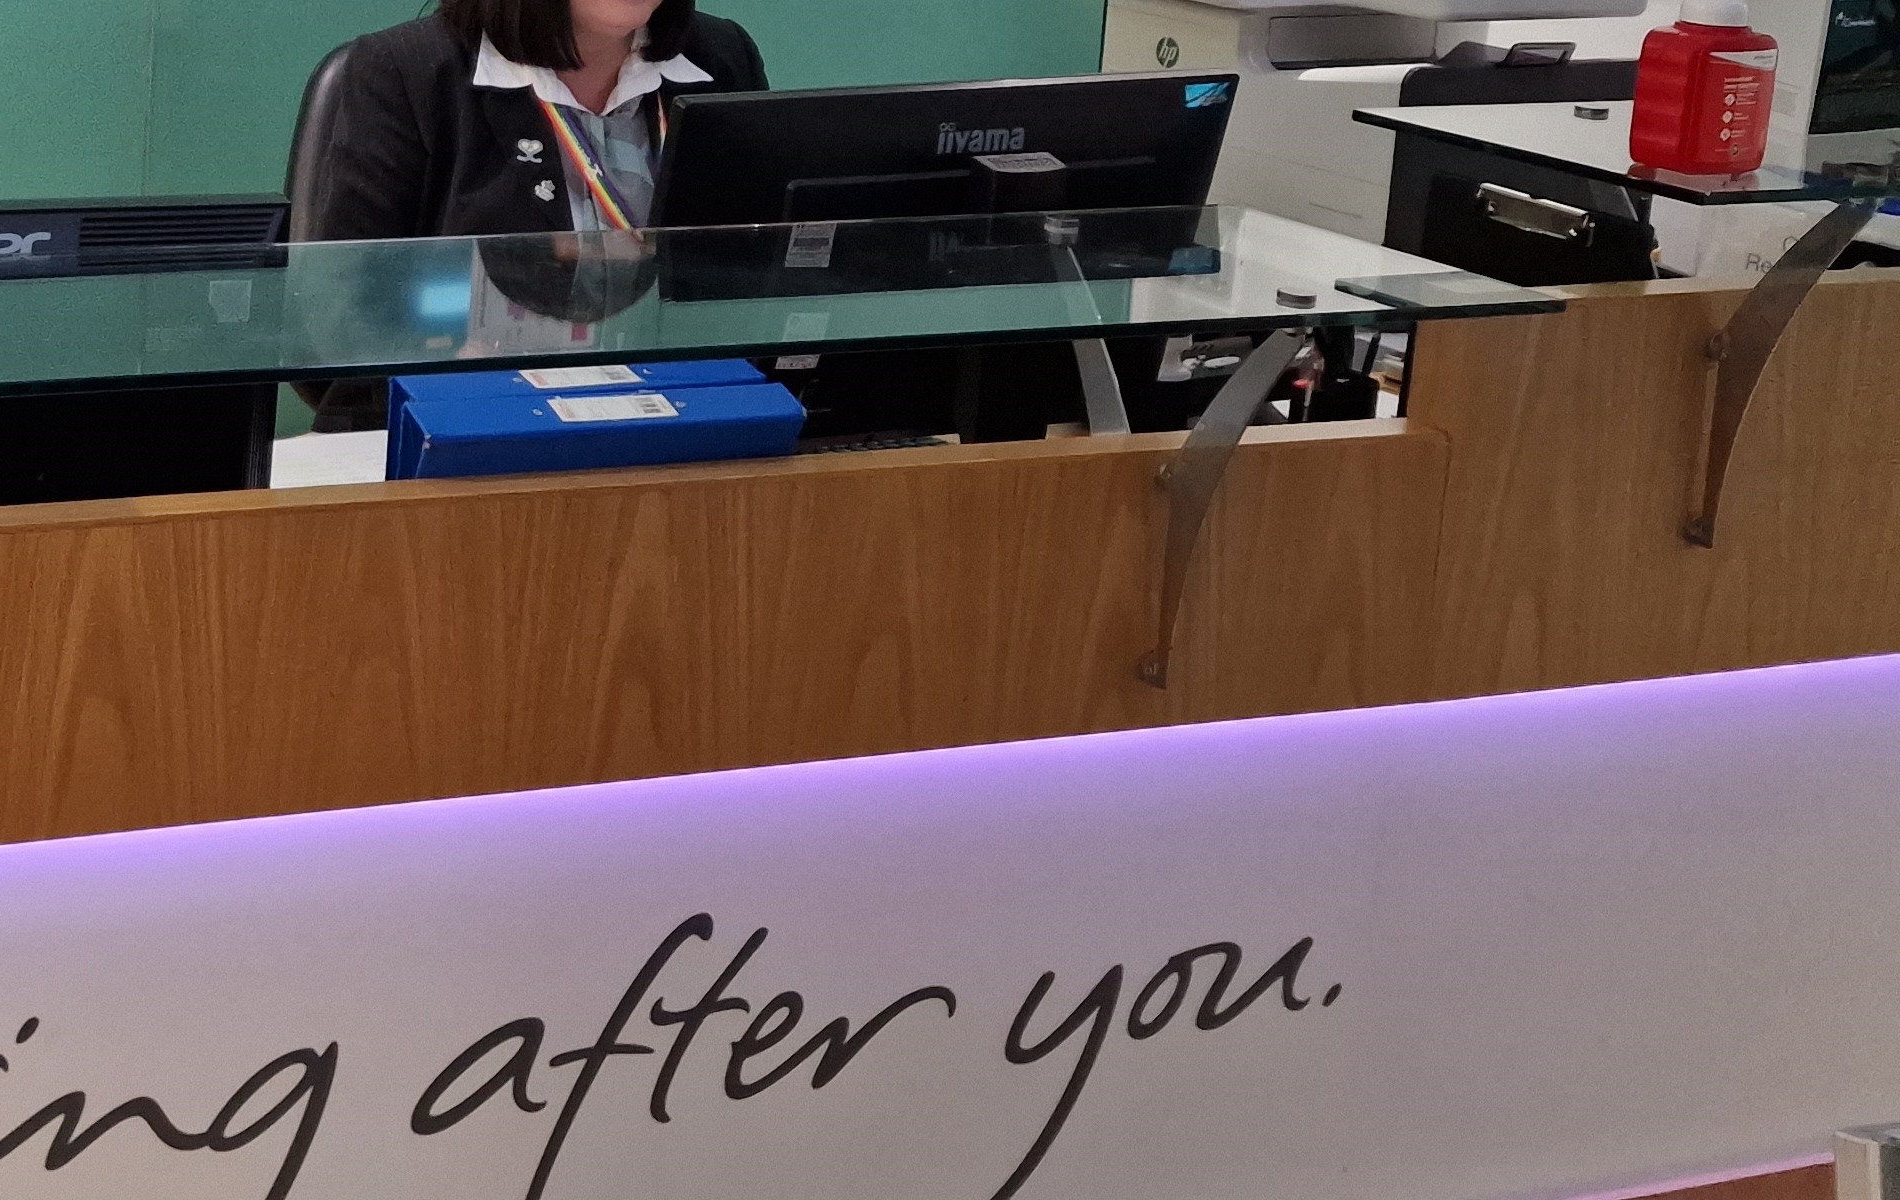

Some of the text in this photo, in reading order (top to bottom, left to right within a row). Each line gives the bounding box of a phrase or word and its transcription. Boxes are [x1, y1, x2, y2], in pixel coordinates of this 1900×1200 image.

[1156, 36, 1179, 68] hp
[937, 122, 1025, 154] iiyama
[410, 912, 957, 1200] after
[988, 936, 1342, 1200] you.
